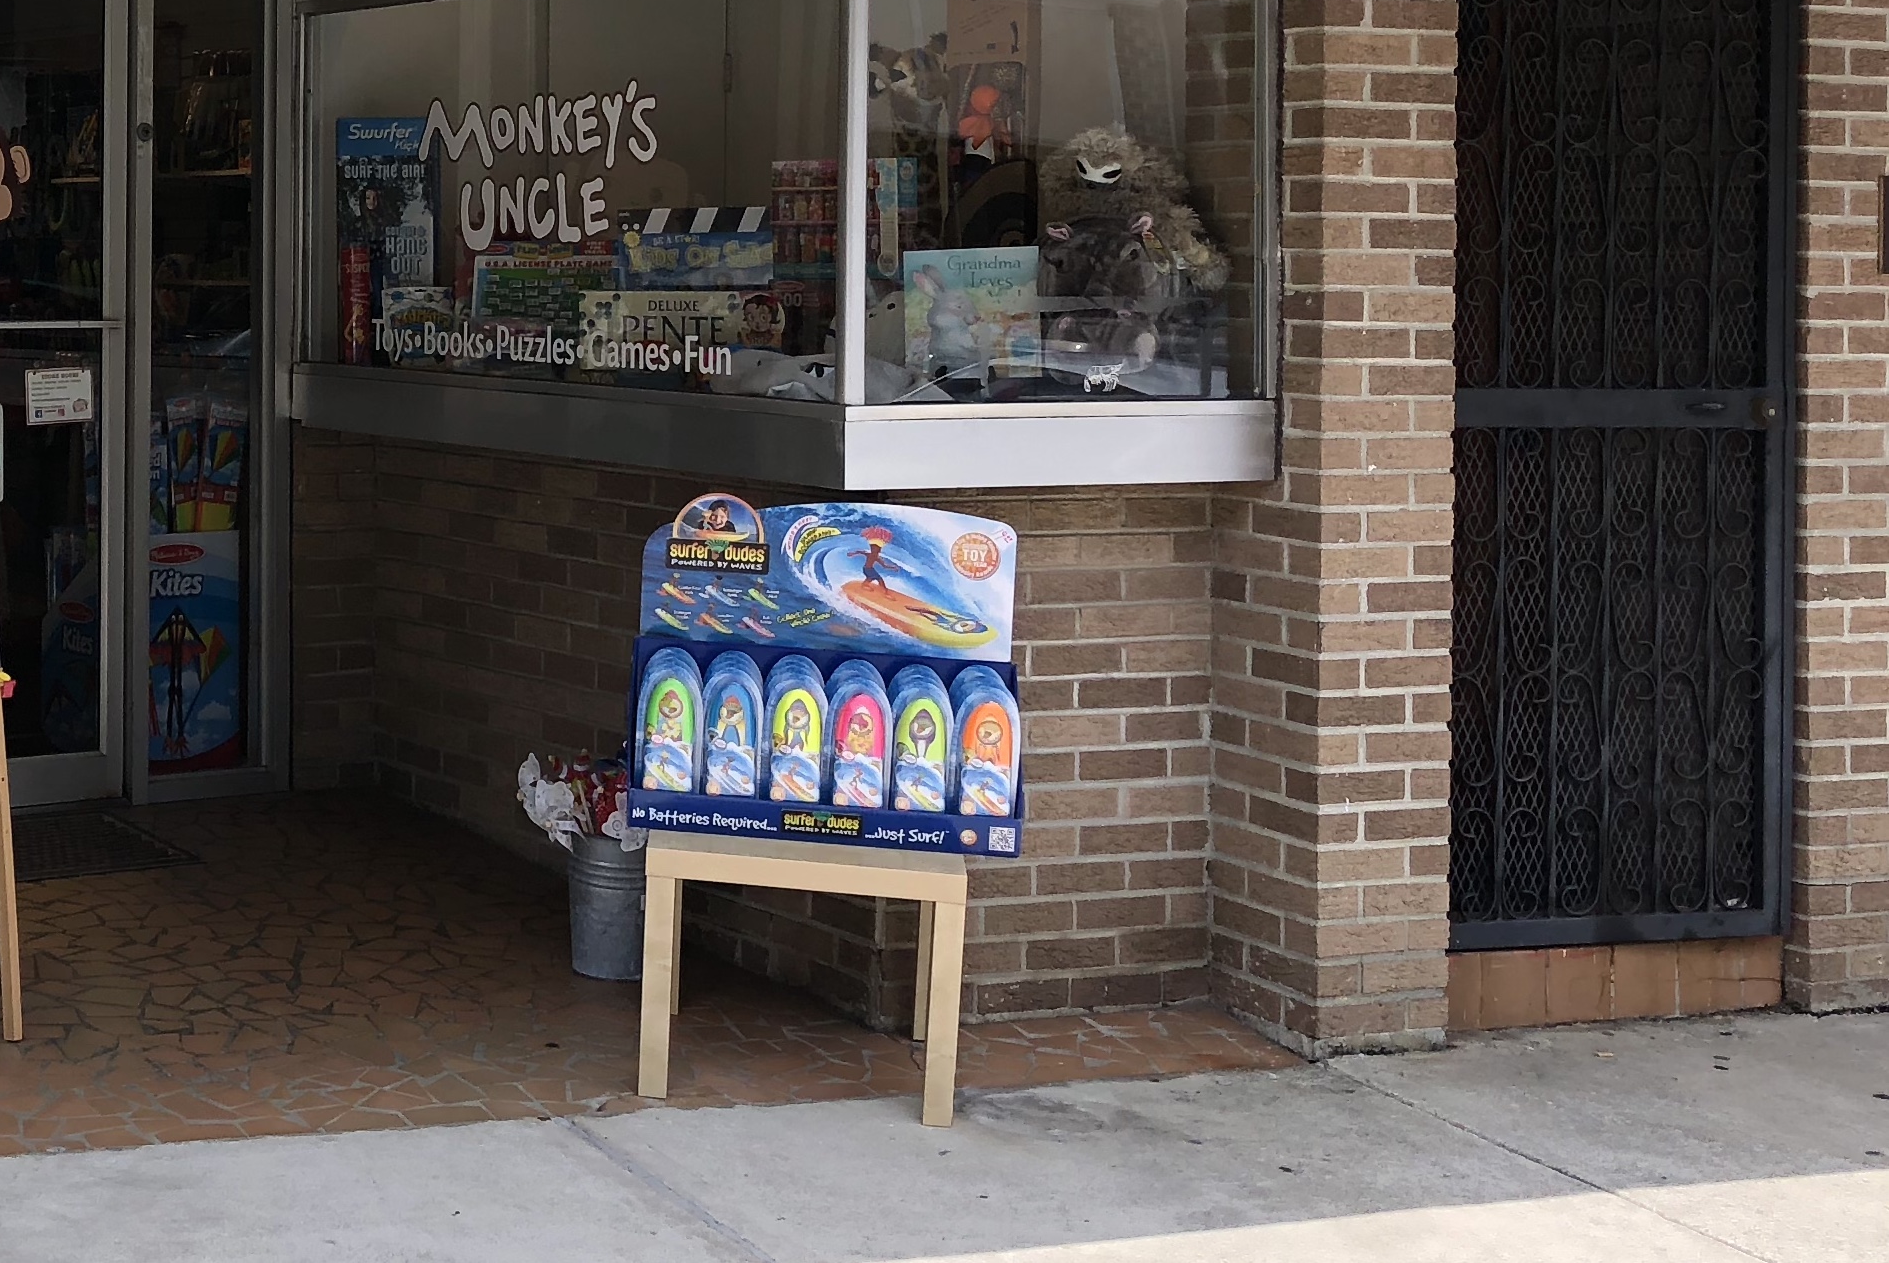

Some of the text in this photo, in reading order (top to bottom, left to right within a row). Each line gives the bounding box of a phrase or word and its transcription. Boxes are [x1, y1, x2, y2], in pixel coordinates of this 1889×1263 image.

[347, 121, 414, 143] Swurfer
[418, 79, 659, 169] MONKEY'S
[459, 172, 610, 252] UNCLE
[947, 255, 1022, 276] Grandma
[969, 271, 1014, 290] Loves
[647, 299, 701, 313] DELUXE
[622, 315, 729, 345] PENTE
[371, 318, 733, 377] Toys Books Puzzles Games Fun
[669, 542, 766, 563] surfer dudes
[961, 548, 989, 562] TOY
[670, 558, 764, 571] POWERED BY WAVES
[149, 570, 203, 597] Kites
[631, 806, 646, 819] No
[648, 806, 710, 826] Batteries
[783, 812, 860, 830] surfer dudes
